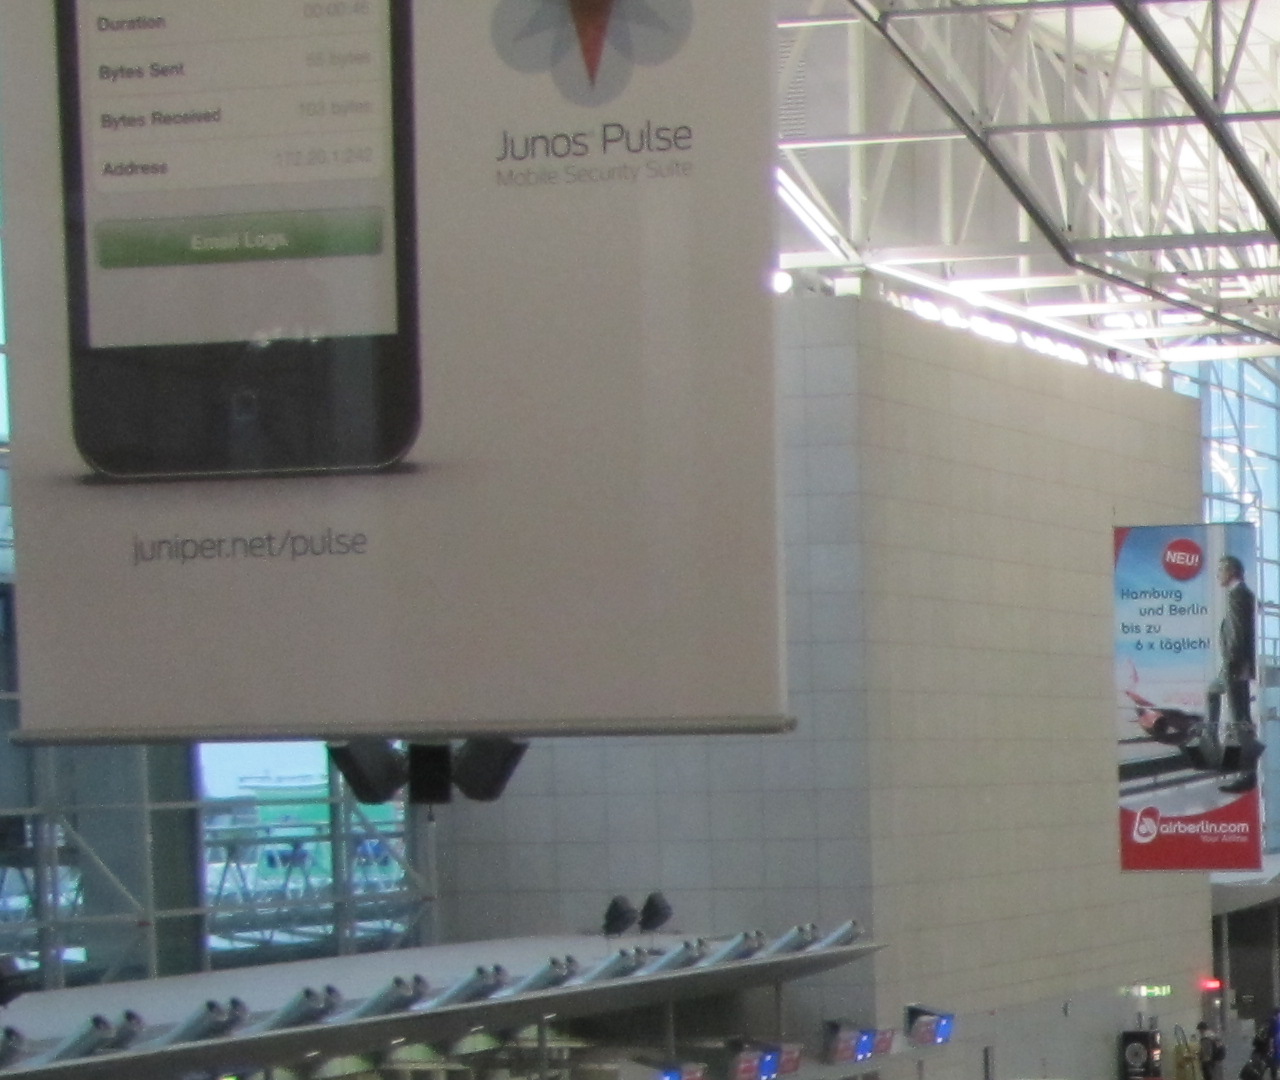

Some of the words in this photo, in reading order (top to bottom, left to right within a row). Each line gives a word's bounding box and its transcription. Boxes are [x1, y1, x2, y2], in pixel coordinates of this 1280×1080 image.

[97, 16, 167, 31] Duration
[98, 64, 145, 82] Bytes
[149, 62, 185, 79] Sent
[101, 112, 146, 130] Bytes
[150, 107, 222, 126] Received
[496, 130, 590, 163] Junos
[601, 120, 693, 154] Pulse
[101, 161, 169, 177] Address
[496, 168, 558, 187] Mobile
[565, 162, 640, 185] Security
[646, 160, 694, 180] Suite
[133, 527, 368, 567] juniper.net/pulse
[1166, 550, 1200, 567] NEU!
[1120, 587, 1183, 602] Hamburg
[1139, 603, 1164, 617] und
[1169, 602, 1208, 616] Berlin
[1120, 621, 1142, 635] bis
[1145, 624, 1162, 634] zu
[1135, 638, 1144, 651] 6
[1147, 641, 1155, 650] x
[1159, 637, 1211, 654] täglich!
[1159, 820, 1250, 834] airberlin.com
